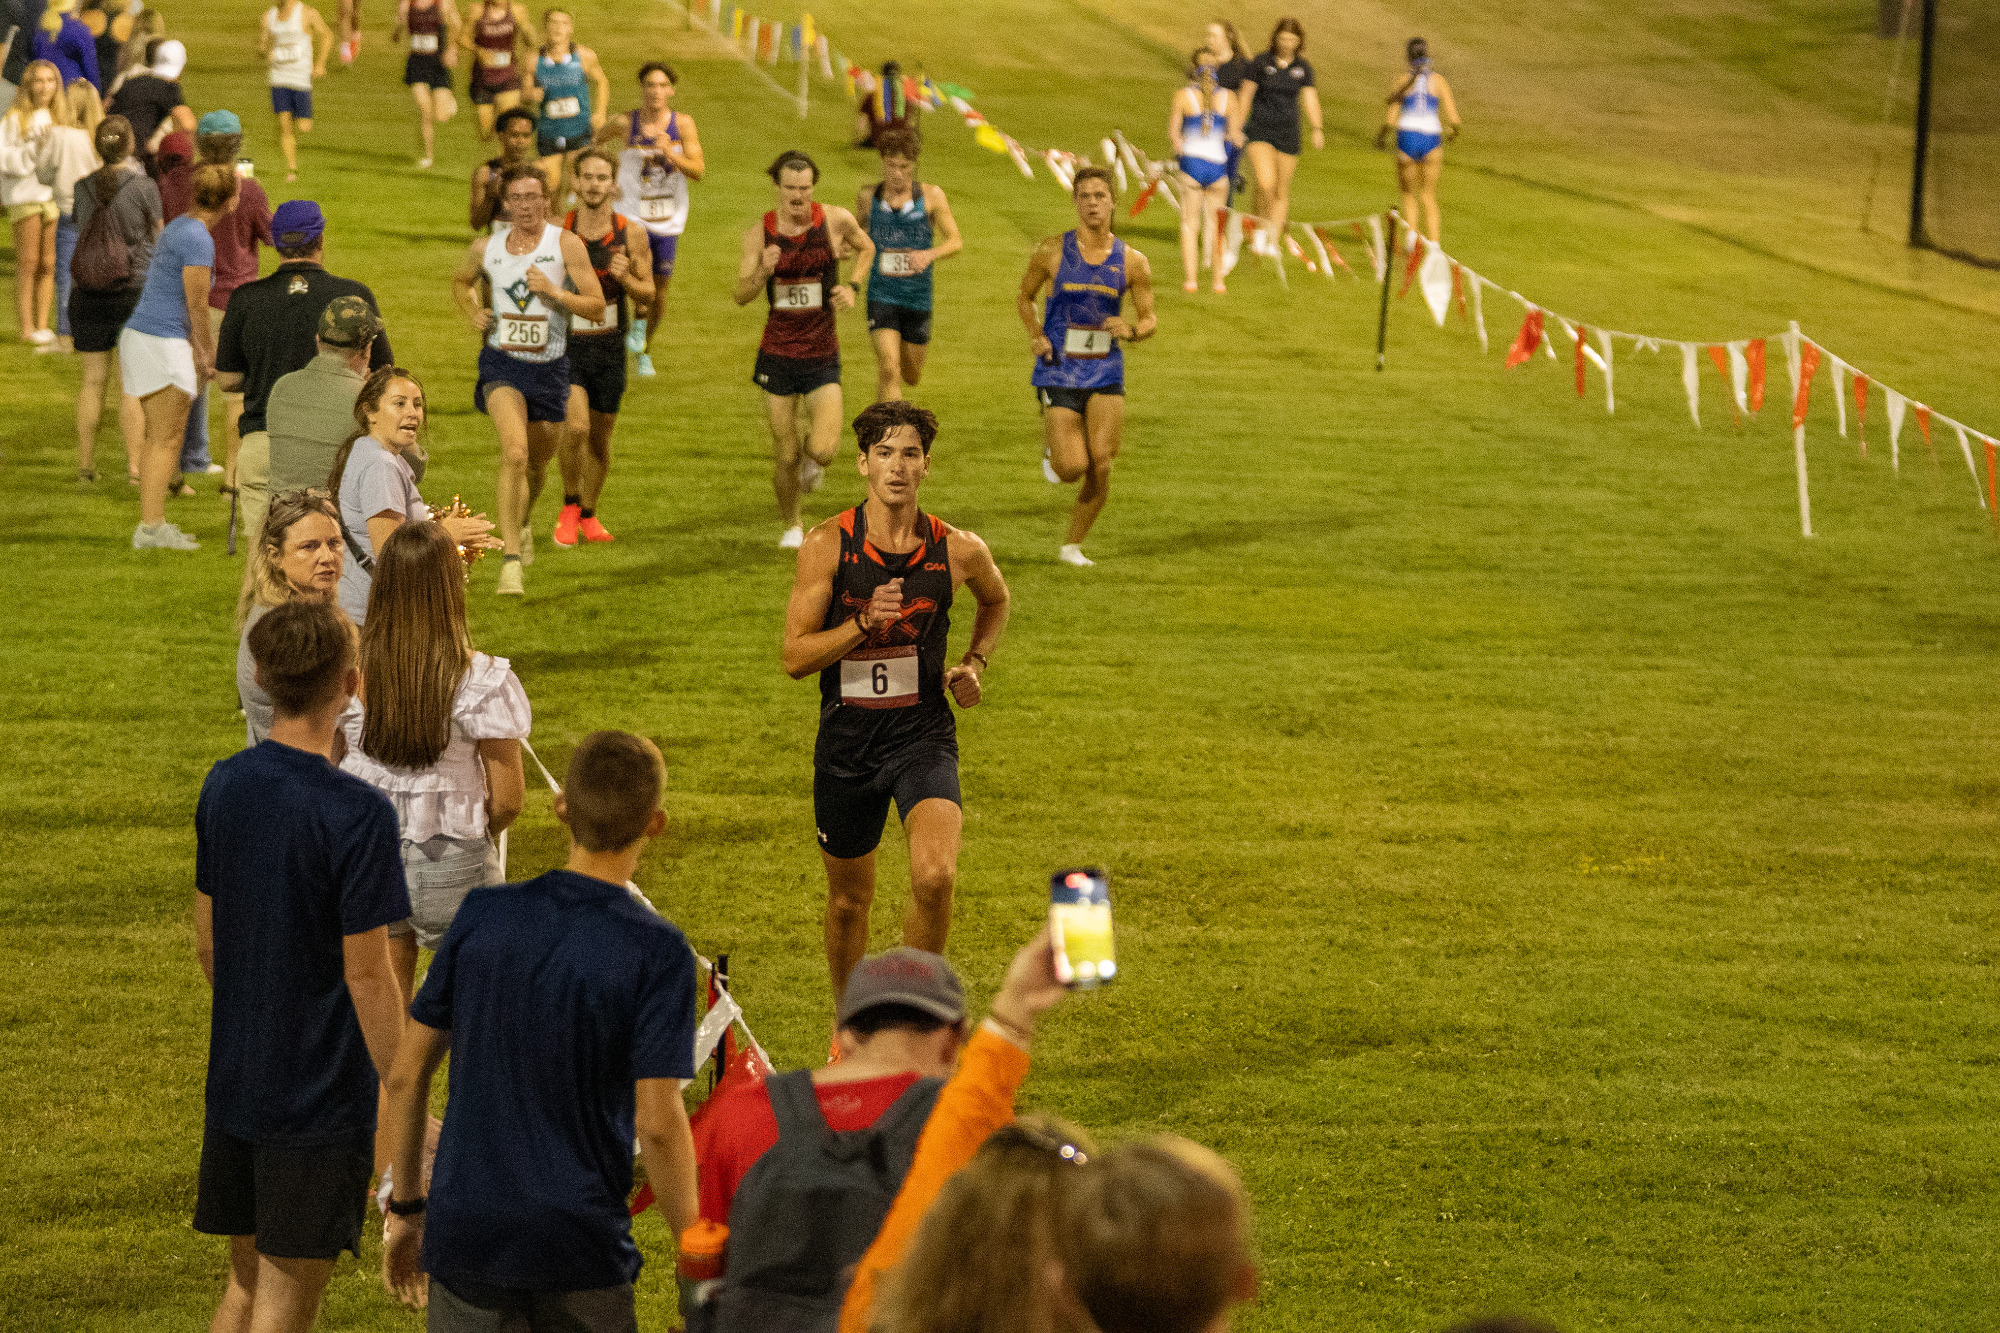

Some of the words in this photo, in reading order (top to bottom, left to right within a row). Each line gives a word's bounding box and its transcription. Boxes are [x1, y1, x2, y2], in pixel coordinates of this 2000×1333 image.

[535, 255, 555, 263] CAA
[788, 286, 809, 305] 56
[508, 322, 540, 344] 256
[1084, 332, 1095, 350] 4
[924, 562, 946, 572] CAA
[872, 662, 888, 695] 6
